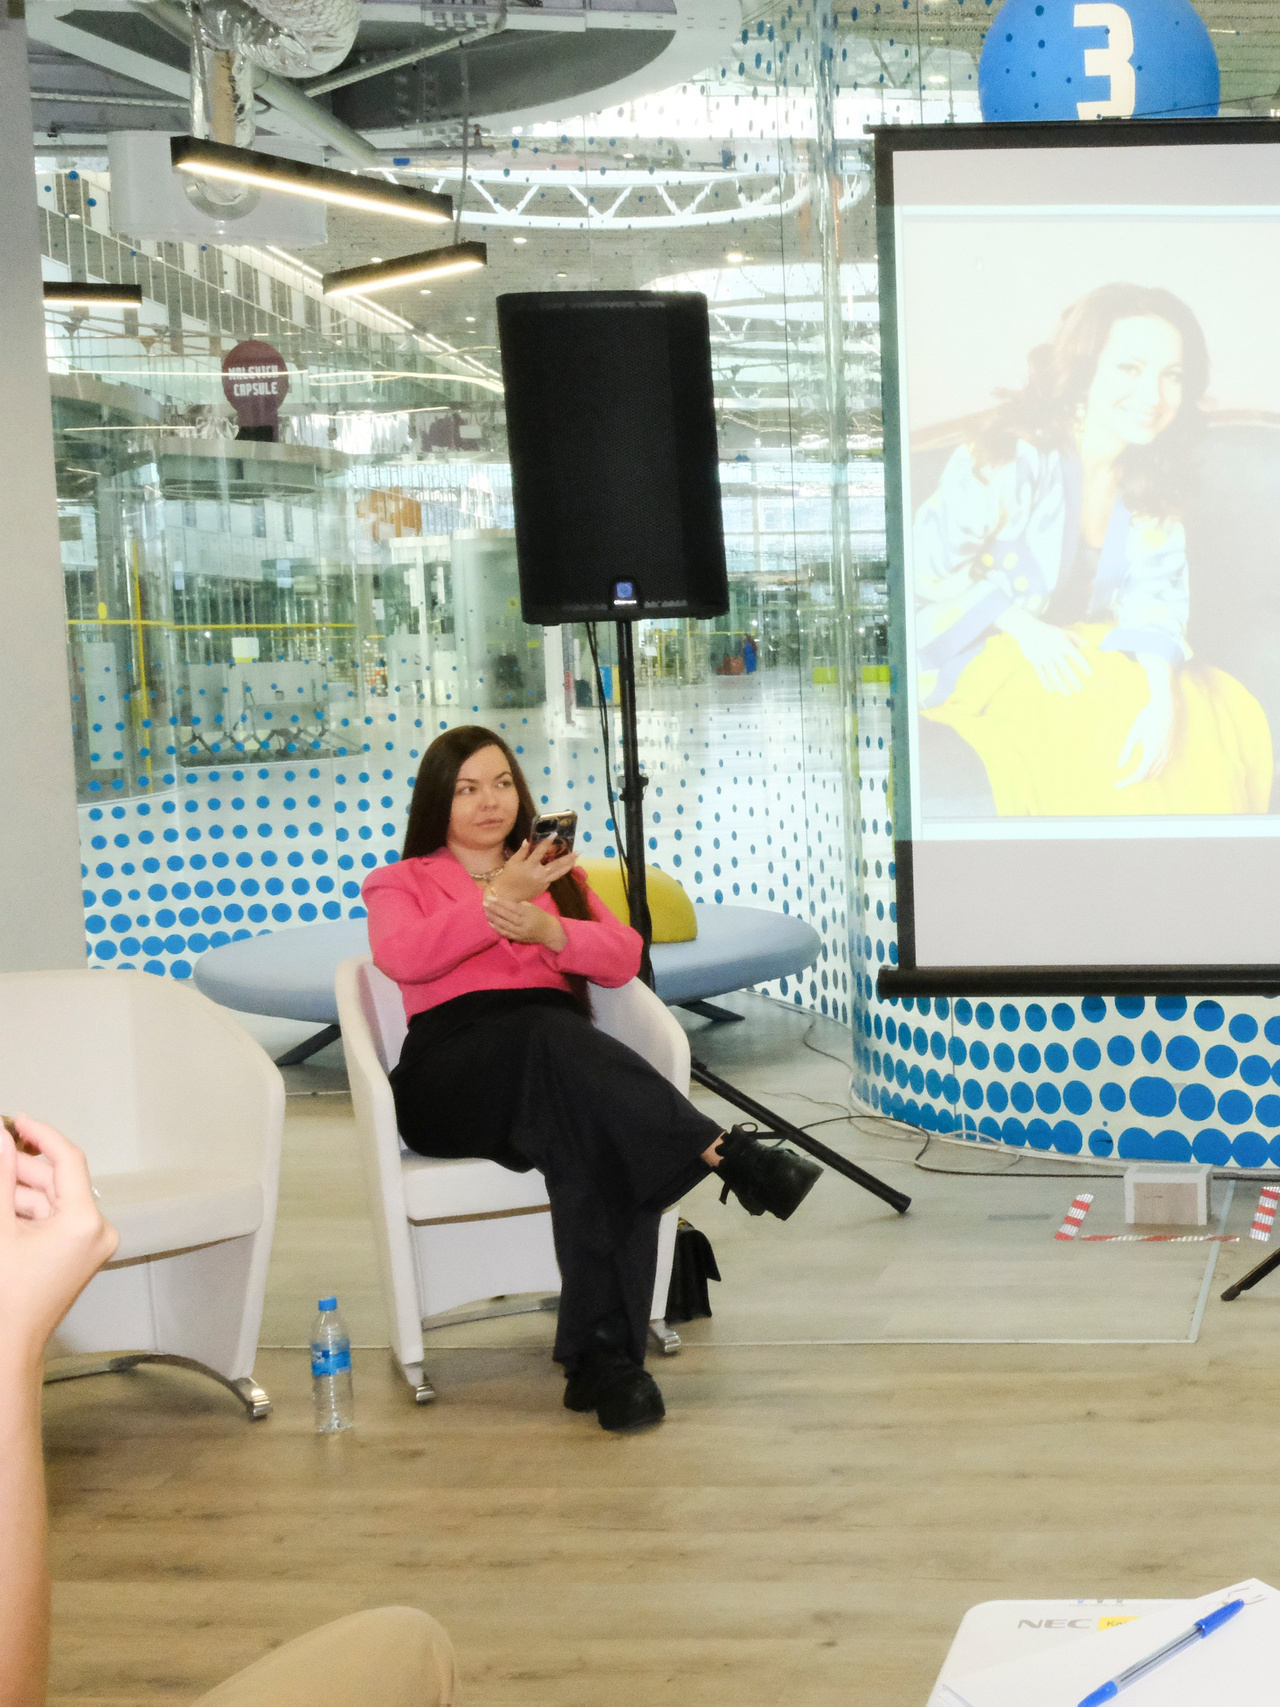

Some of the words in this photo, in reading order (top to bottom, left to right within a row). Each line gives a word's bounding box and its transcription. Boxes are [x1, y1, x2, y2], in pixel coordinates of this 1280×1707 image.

[1073, 3, 1136, 120] 3
[233, 381, 278, 397] CAPSULE
[1017, 1618, 1093, 1629] NEC
